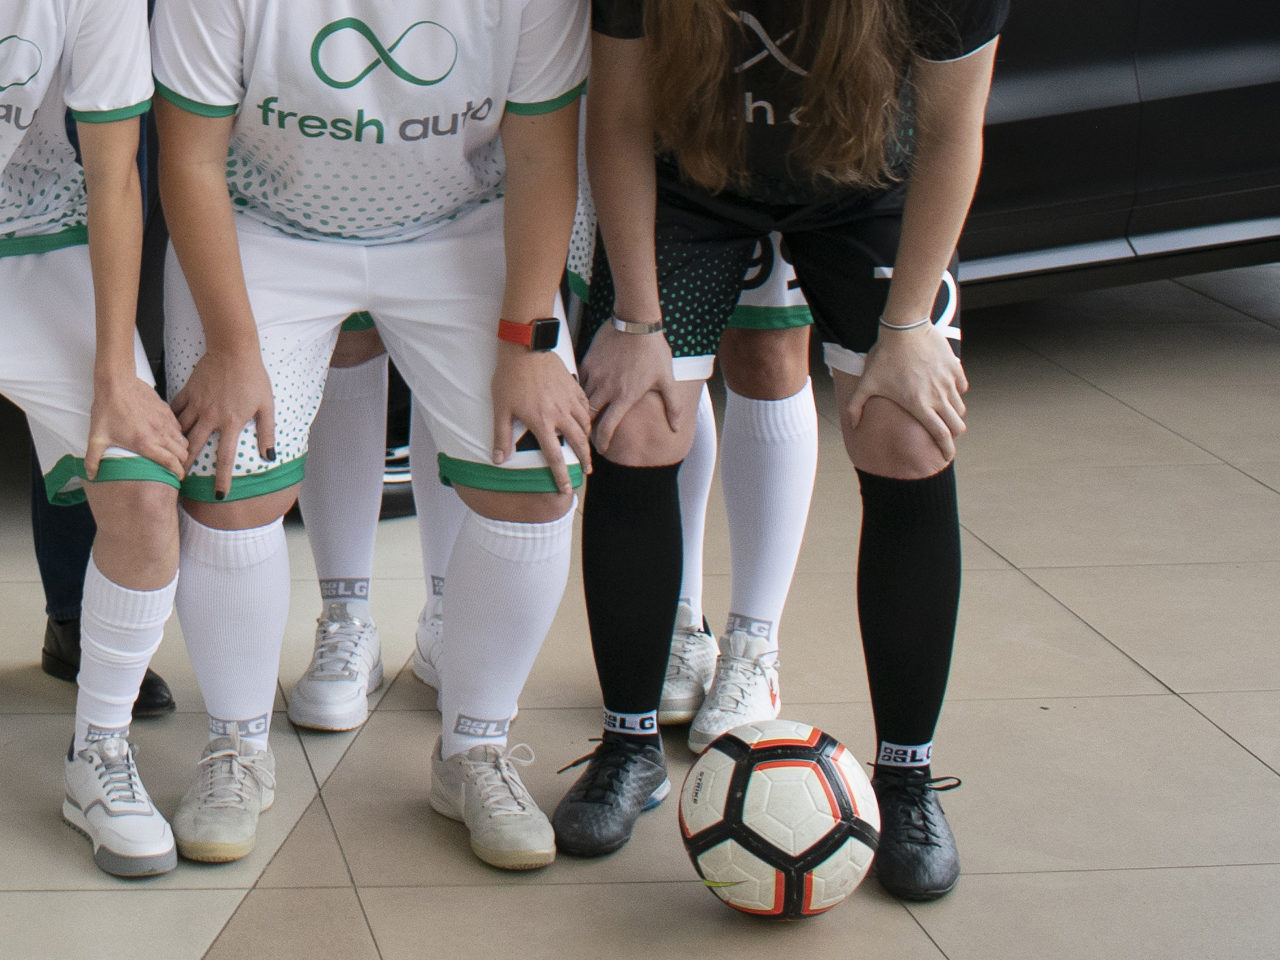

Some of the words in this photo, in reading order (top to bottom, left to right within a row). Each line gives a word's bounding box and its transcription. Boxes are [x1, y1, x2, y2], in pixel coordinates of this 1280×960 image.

[257, 96, 385, 145] fresh
[399, 97, 493, 142] auto
[619, 716, 654, 730] LG
